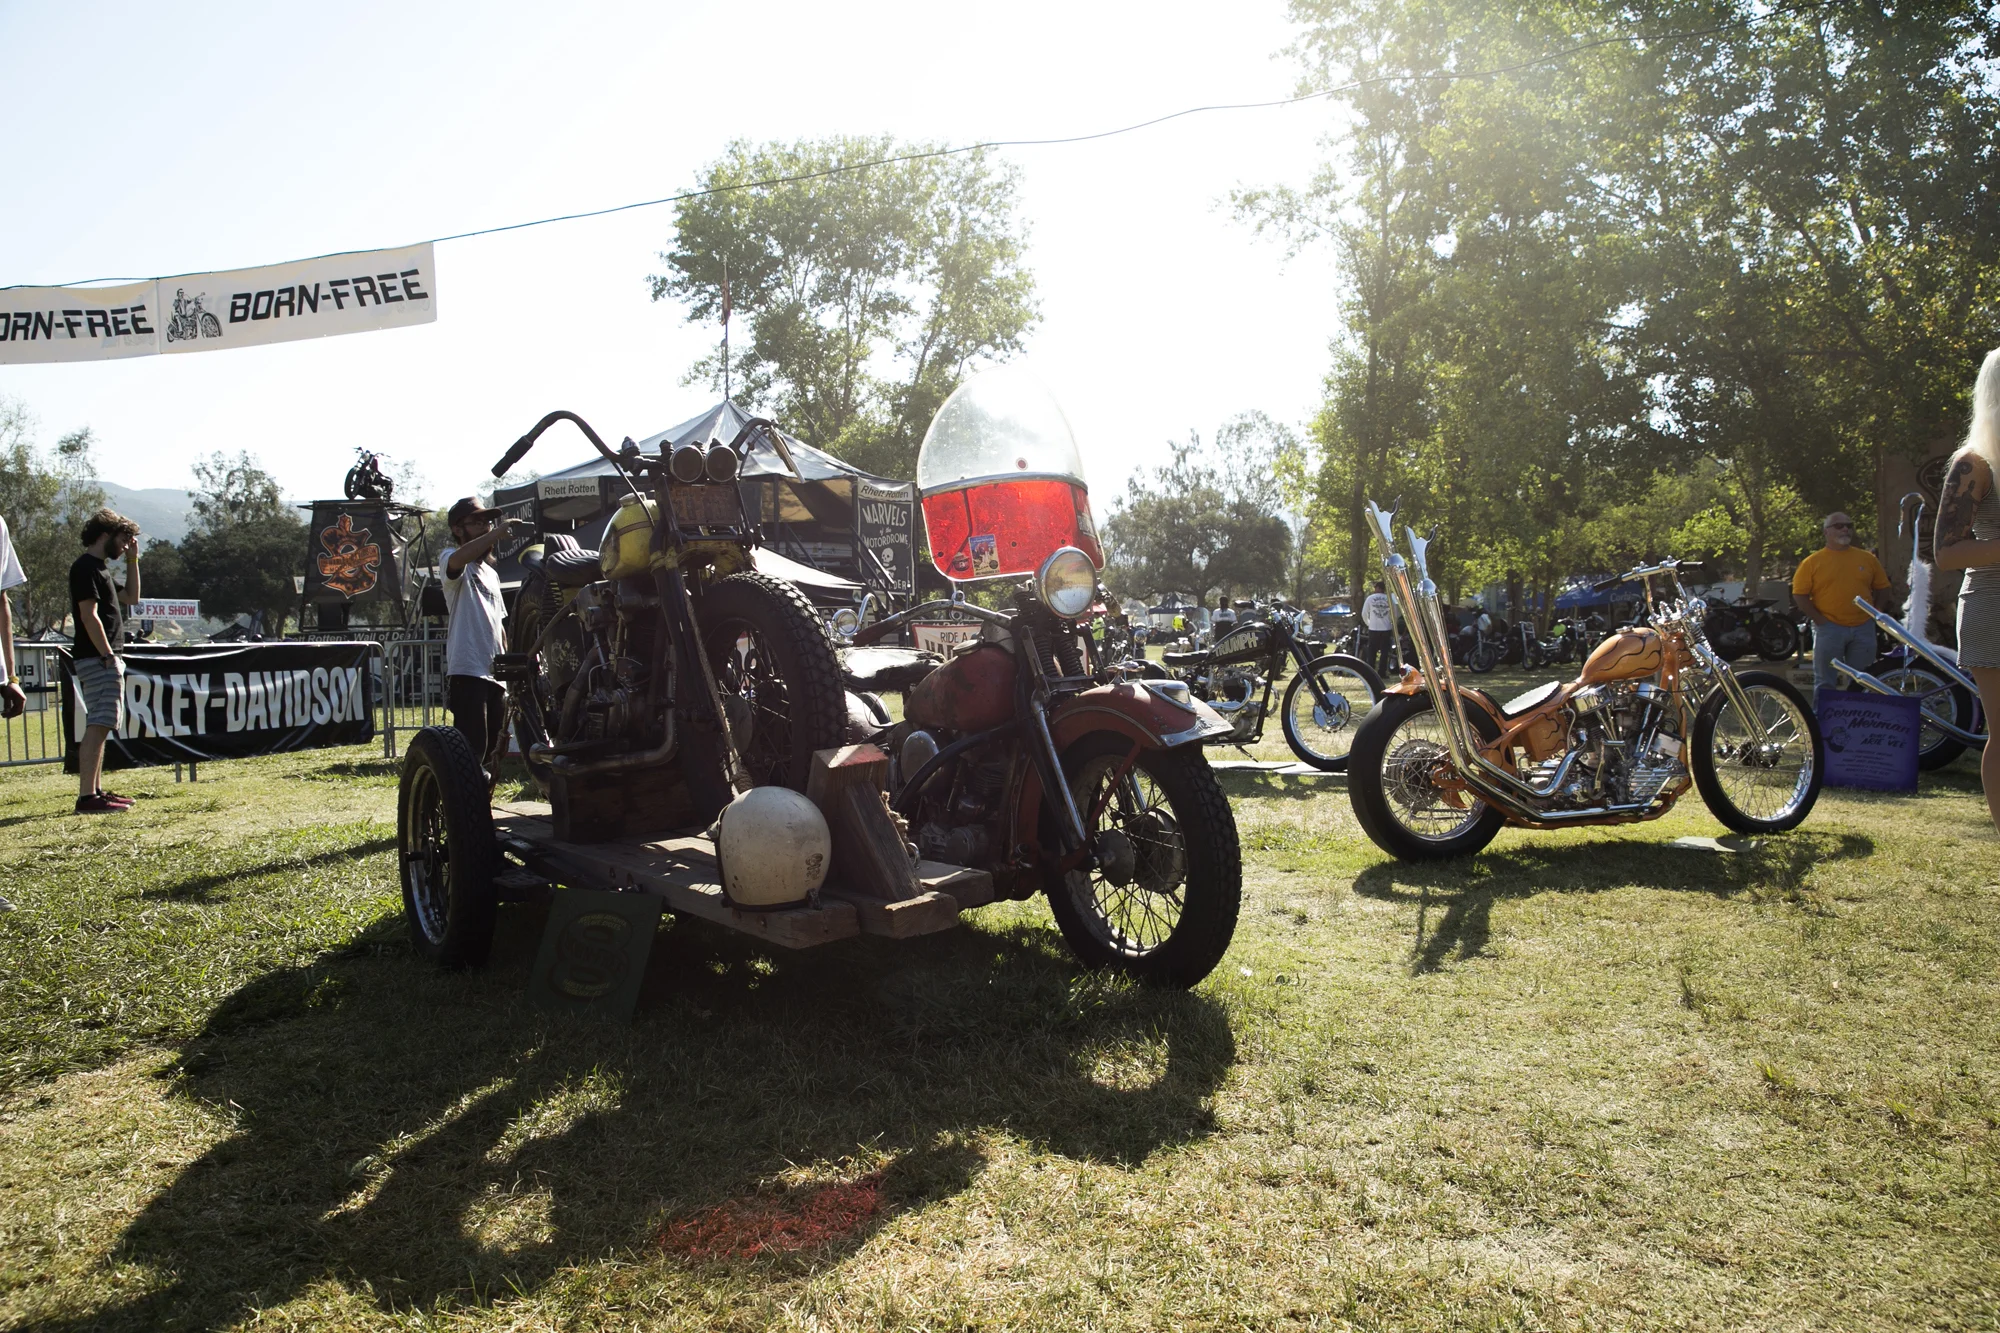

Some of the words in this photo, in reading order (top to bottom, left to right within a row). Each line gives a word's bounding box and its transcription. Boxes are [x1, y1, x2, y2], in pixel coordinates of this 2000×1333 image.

[230, 269, 429, 324] BORN-FREE
[544, 486, 566, 496] Rhett
[569, 484, 596, 494] Rotten
[861, 485, 884, 498] Rhett
[862, 503, 908, 527] MARVELS
[864, 533, 909, 549] MOTORDROME
[146, 605, 165, 616] FXR
[168, 605, 196, 616] SHOW
[354, 631, 376, 642] Wall
[379, 631, 390, 641] of
[940, 632, 959, 644] RIDE
[961, 631, 968, 643] A
[1212, 632, 1259, 657] TRIUMPH
[1823, 708, 1881, 720] German
[1848, 717, 1911, 734] Merman
